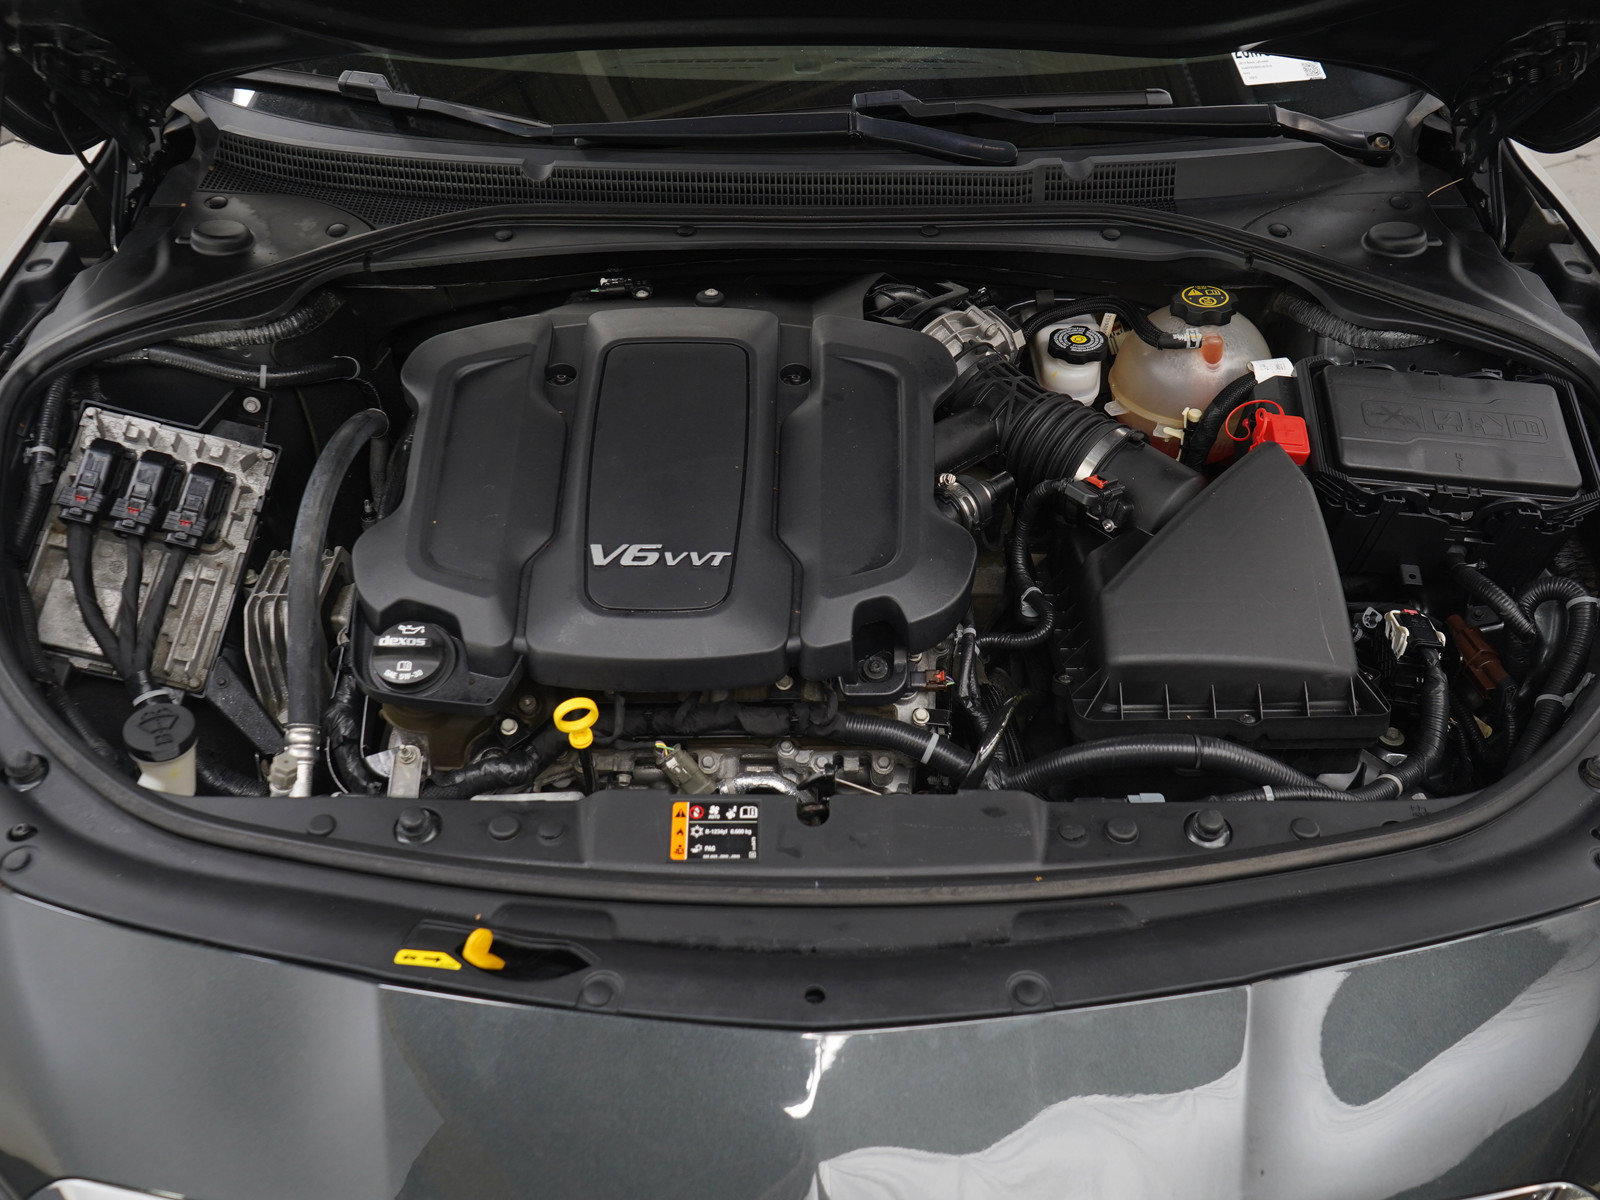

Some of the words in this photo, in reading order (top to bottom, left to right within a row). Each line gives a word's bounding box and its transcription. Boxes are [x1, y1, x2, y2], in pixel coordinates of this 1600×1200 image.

[590, 544, 663, 566] V6
[664, 551, 732, 566] VVT
[378, 635, 427, 646] dexos
[383, 669, 398, 679] SAE
